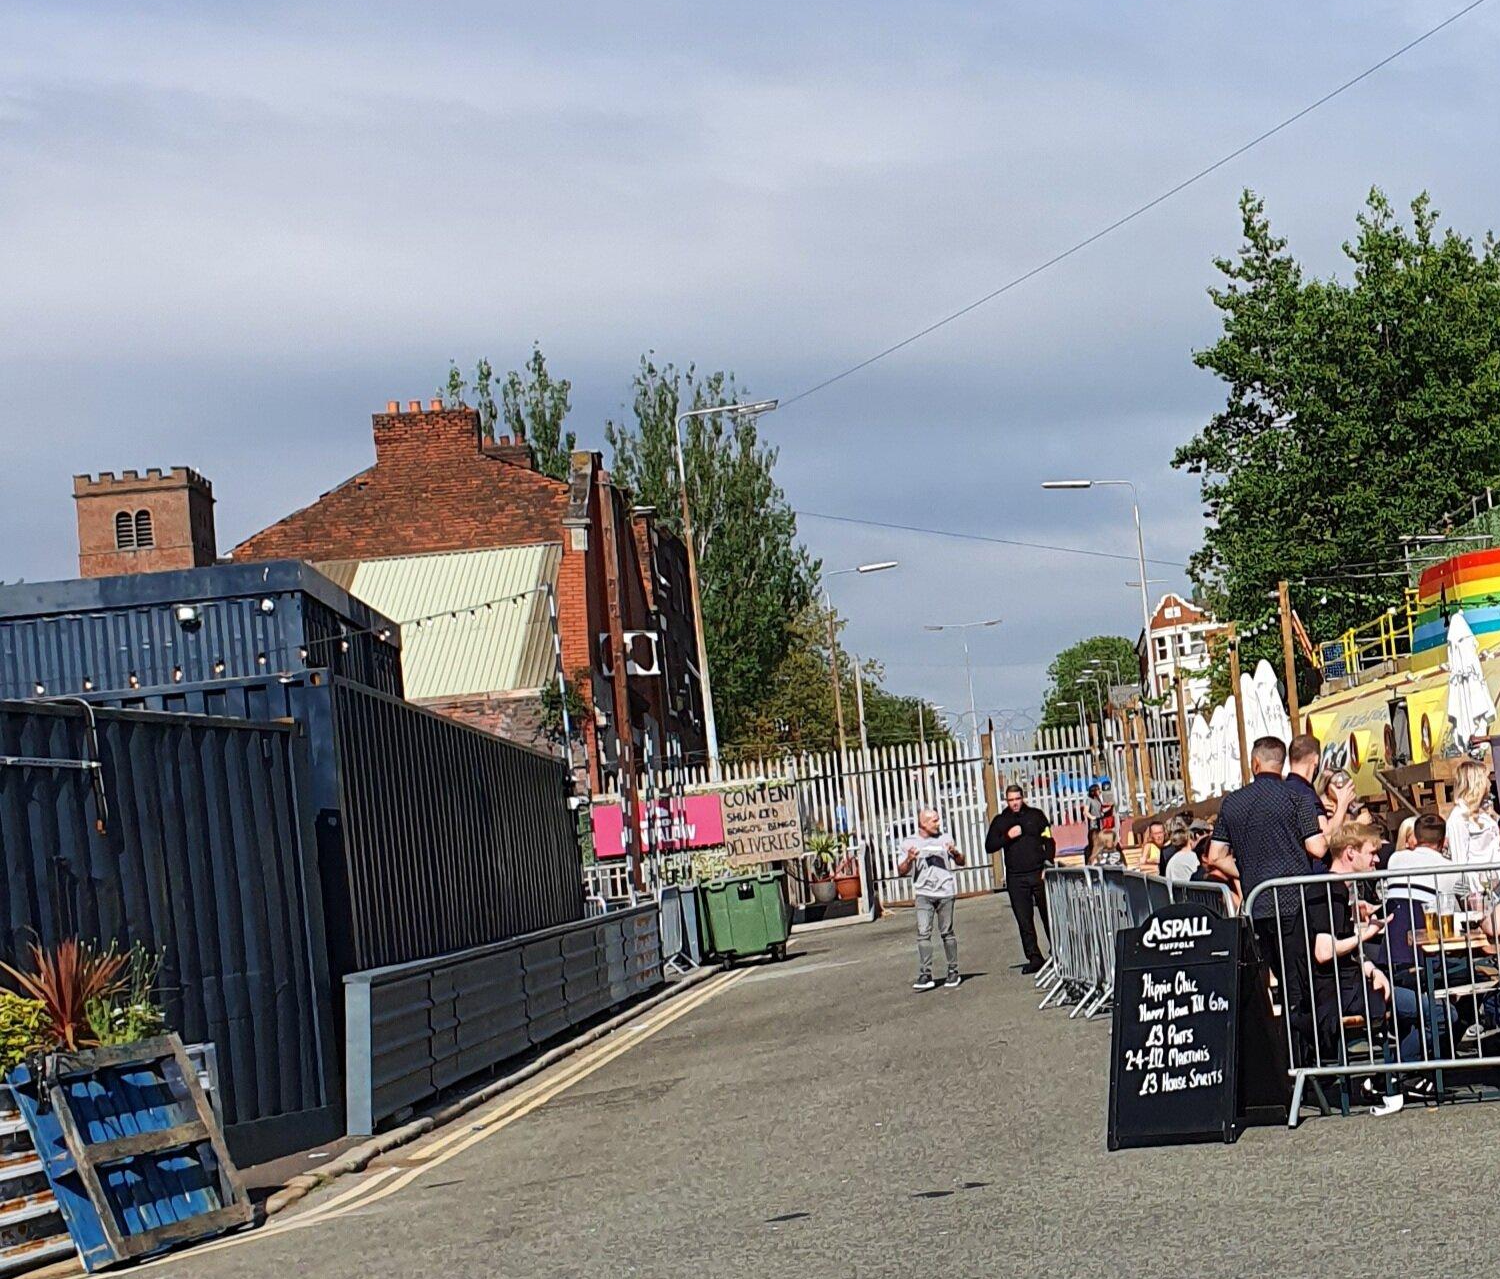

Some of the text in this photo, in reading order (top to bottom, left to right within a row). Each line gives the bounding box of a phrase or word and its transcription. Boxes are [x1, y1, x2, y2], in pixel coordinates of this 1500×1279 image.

[724, 785, 796, 809] CONTENT
[726, 832, 800, 857] DELIVERIES
[1143, 916, 1212, 948] ASPALL
[1159, 941, 1195, 951] SUFFOLK
[1175, 970, 1199, 996] Chic
[1145, 1024, 1164, 1047] £3
[1139, 1072, 1158, 1096] £3
